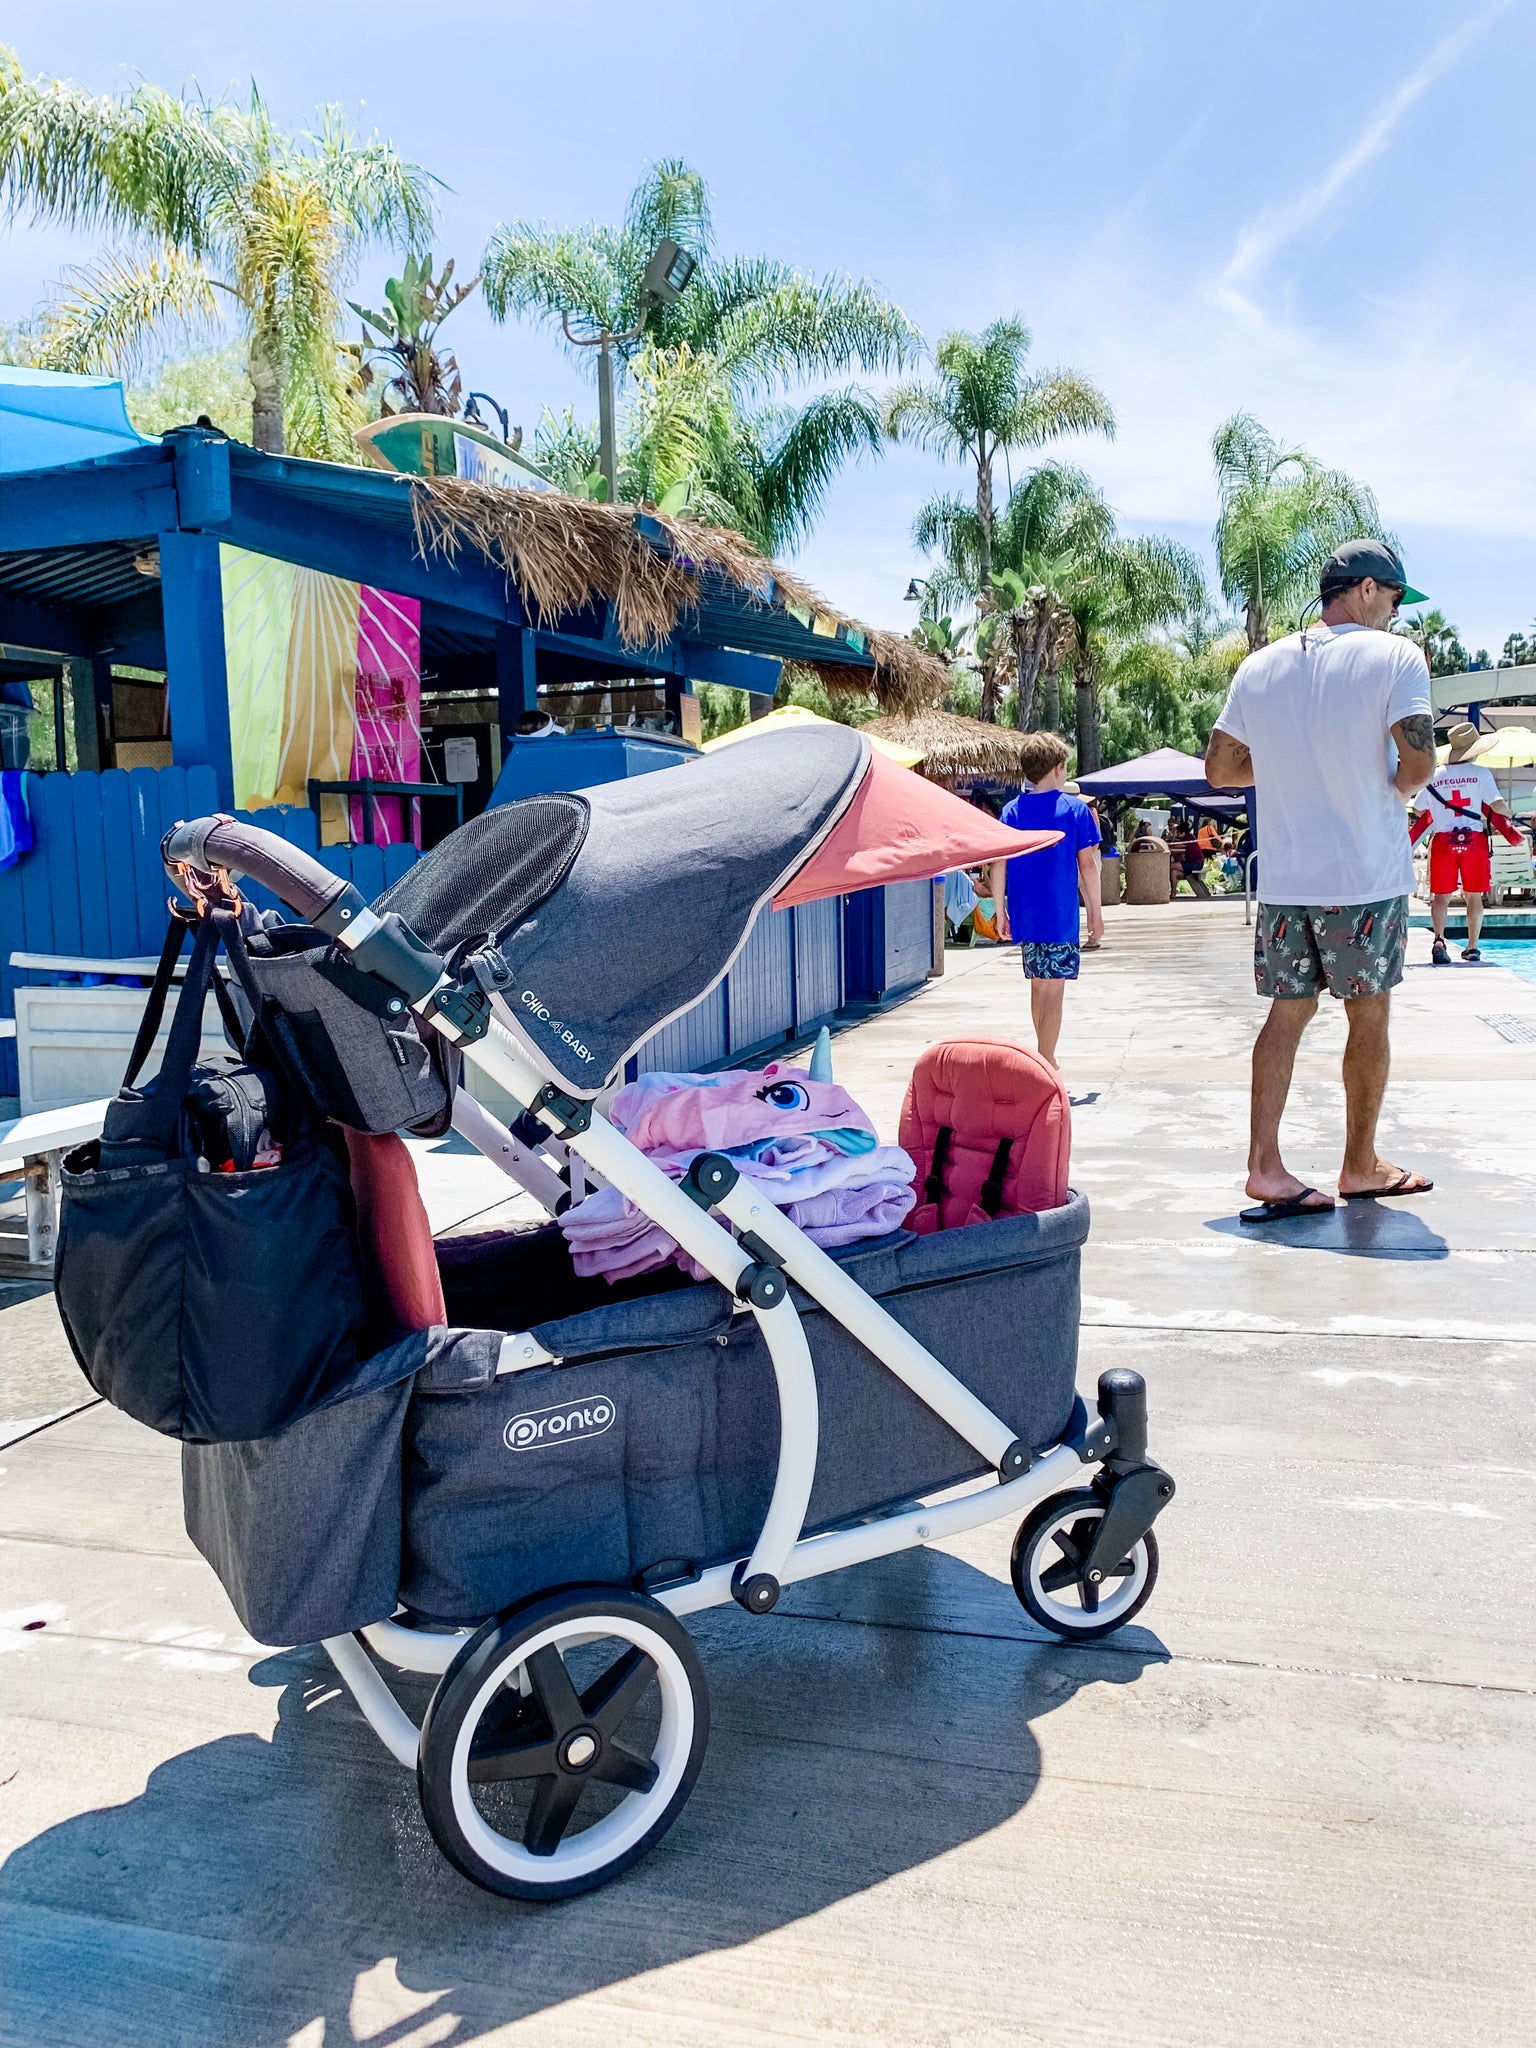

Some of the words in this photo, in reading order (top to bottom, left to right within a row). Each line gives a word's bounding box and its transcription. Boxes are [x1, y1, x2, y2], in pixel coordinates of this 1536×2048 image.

[1432, 777, 1478, 788] LIFEGUARD
[521, 990, 551, 1022] CHIC
[548, 1021, 564, 1034] 4
[560, 1030, 596, 1064] BABY
